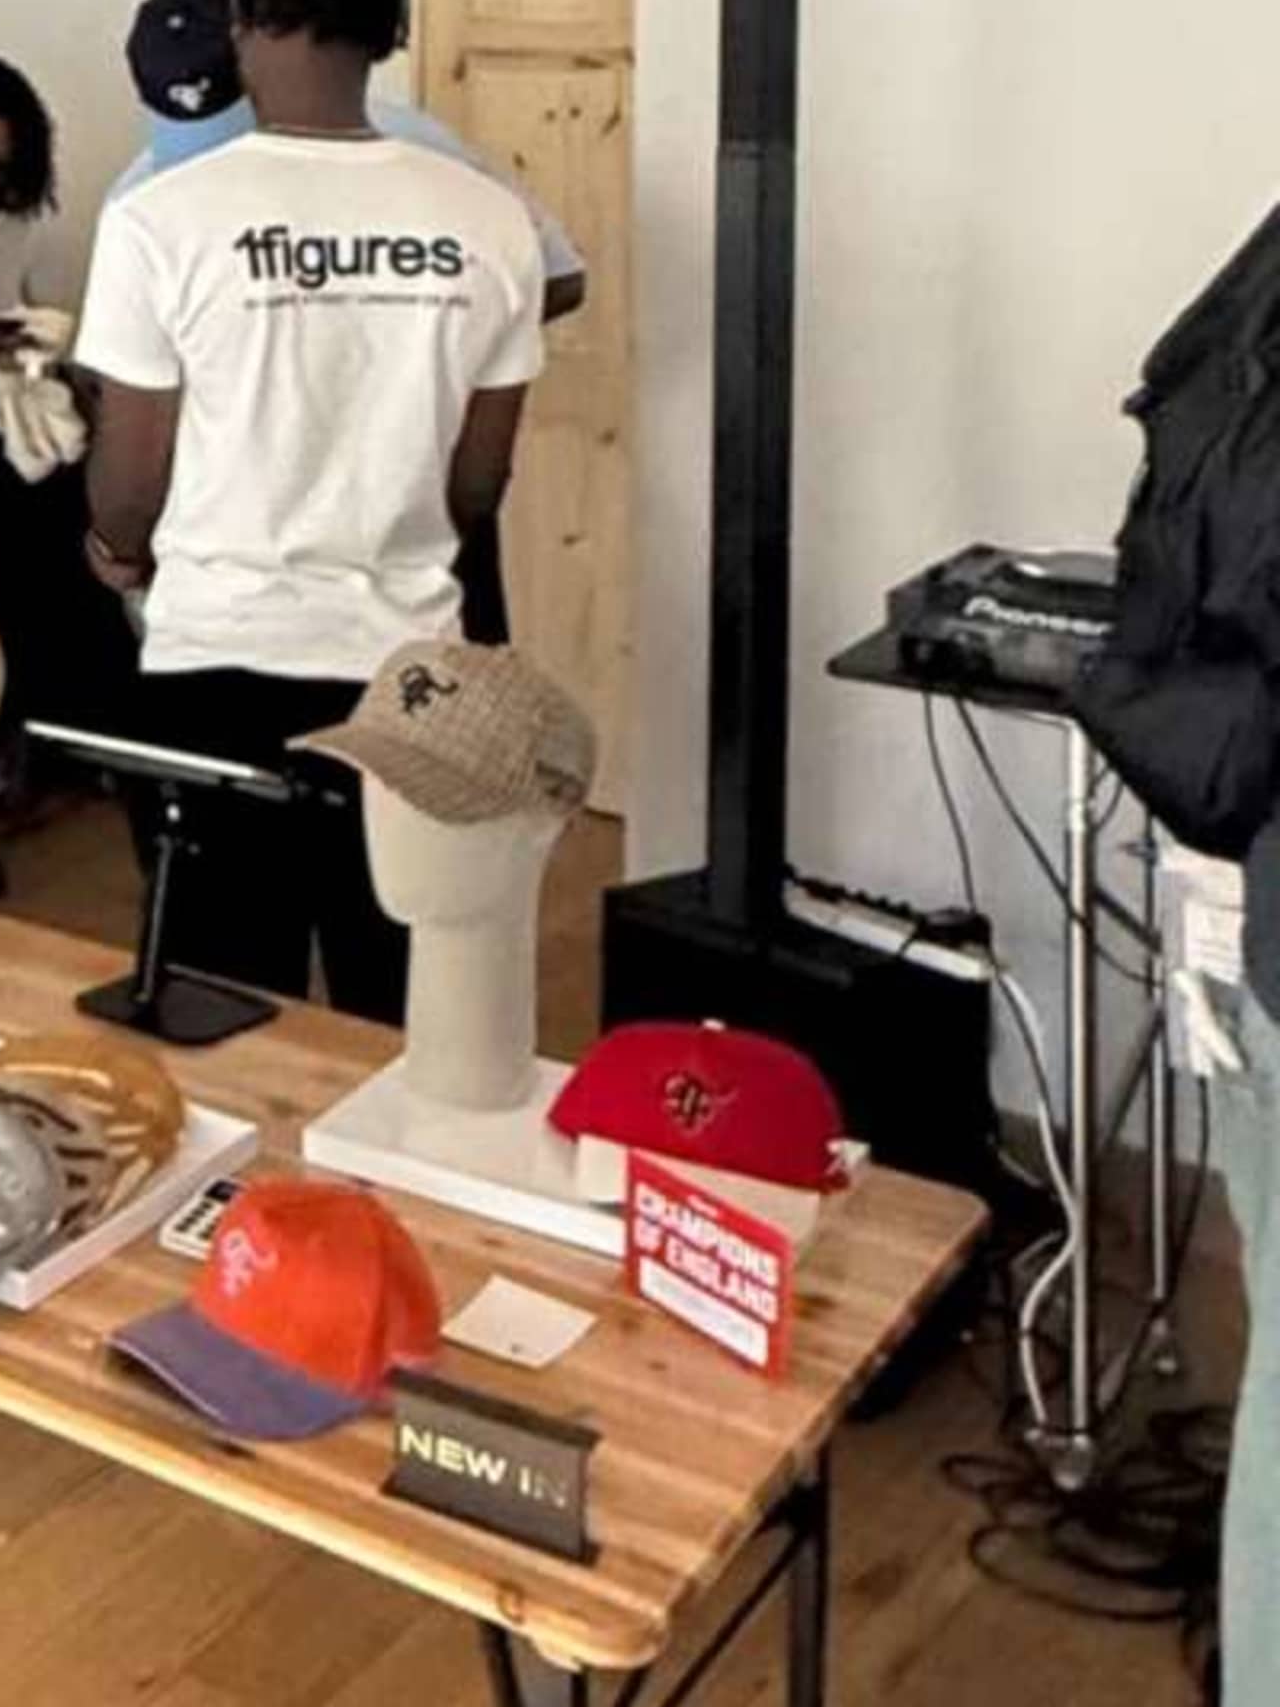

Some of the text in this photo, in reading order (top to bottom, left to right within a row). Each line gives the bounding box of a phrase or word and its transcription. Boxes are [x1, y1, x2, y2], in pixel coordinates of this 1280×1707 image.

[633, 1181, 780, 1288] CHAMPIONS
[633, 1214, 664, 1255] OF
[665, 1235, 779, 1325] ENGLAND
[400, 1423, 567, 1509] NEW IN
